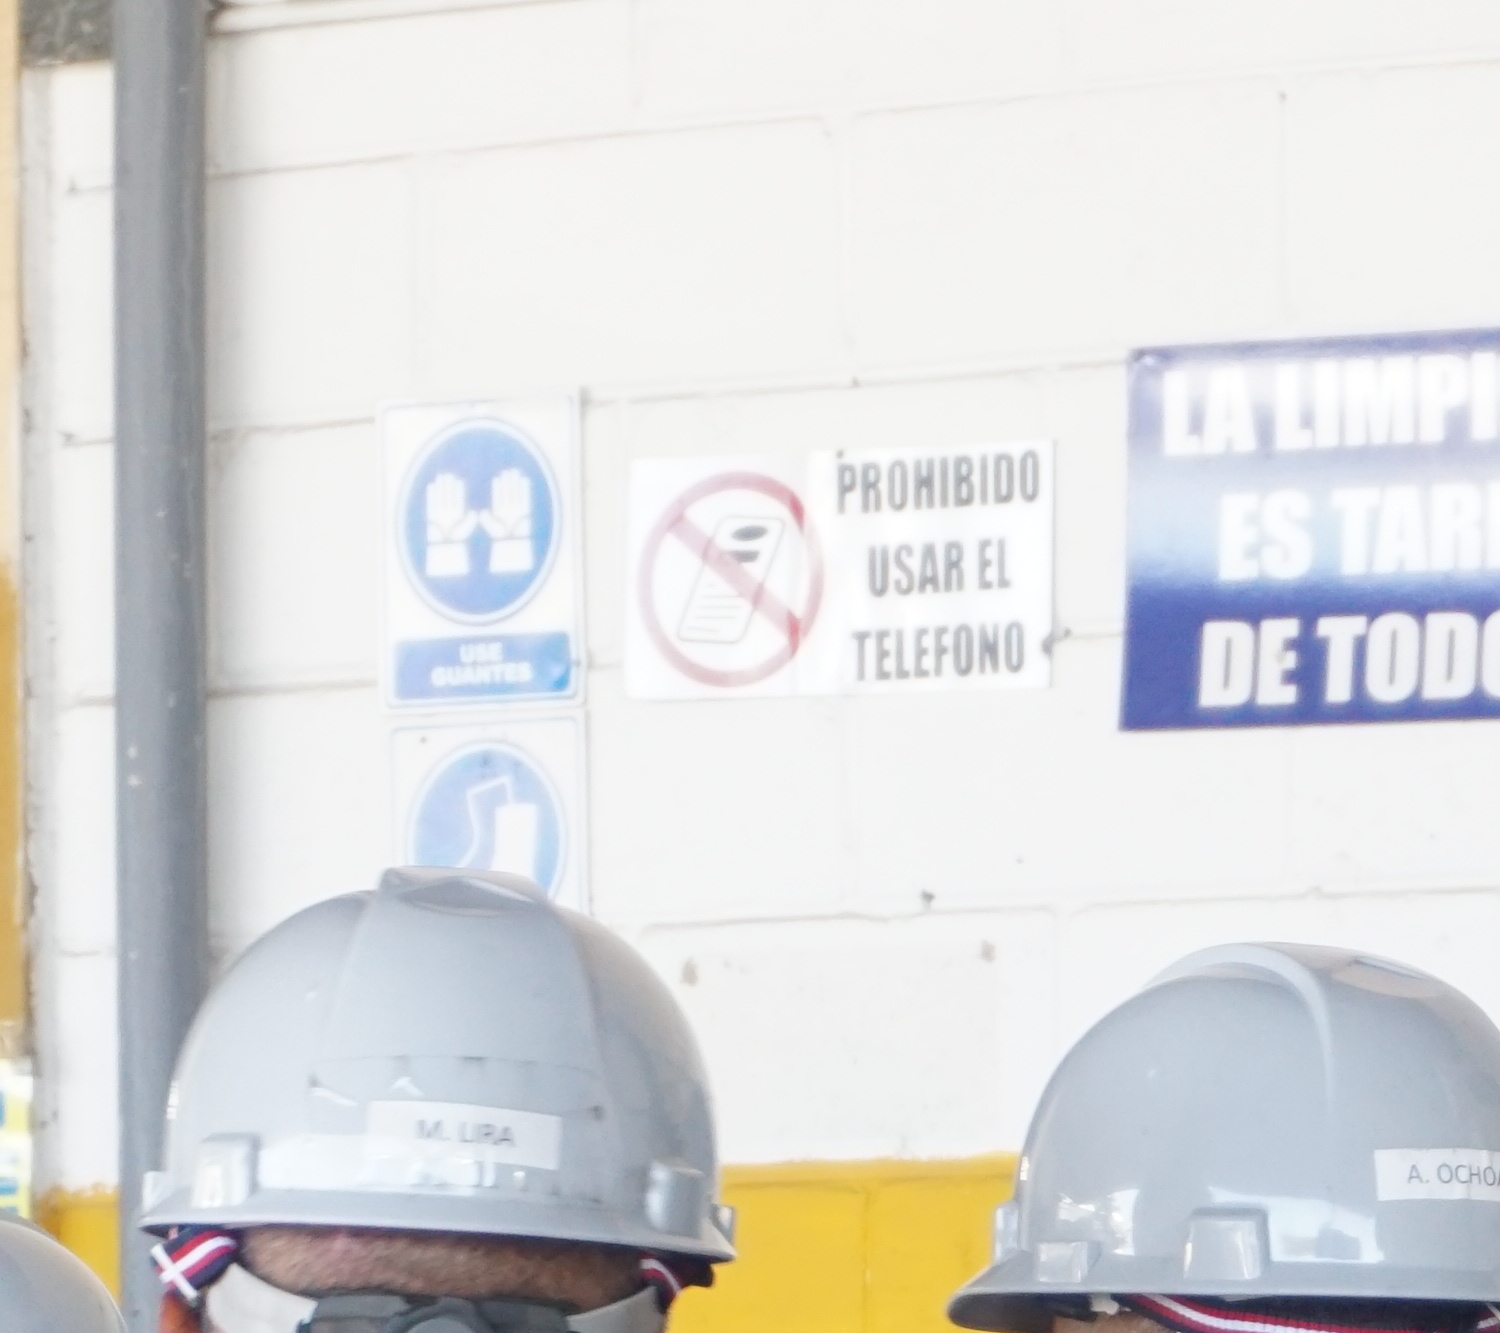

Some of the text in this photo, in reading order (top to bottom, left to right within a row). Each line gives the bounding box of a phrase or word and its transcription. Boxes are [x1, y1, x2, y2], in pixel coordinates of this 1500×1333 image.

[1163, 367, 1256, 456] LA
[837, 450, 1039, 514] PROHIBIDO
[1218, 490, 1311, 582] ES
[868, 538, 1011, 597] USAR EL
[852, 621, 1024, 681] TELEFONO
[1199, 618, 1299, 707] DE
[458, 1121, 517, 1148] LIRA
[1406, 1164, 1430, 1184] A.
